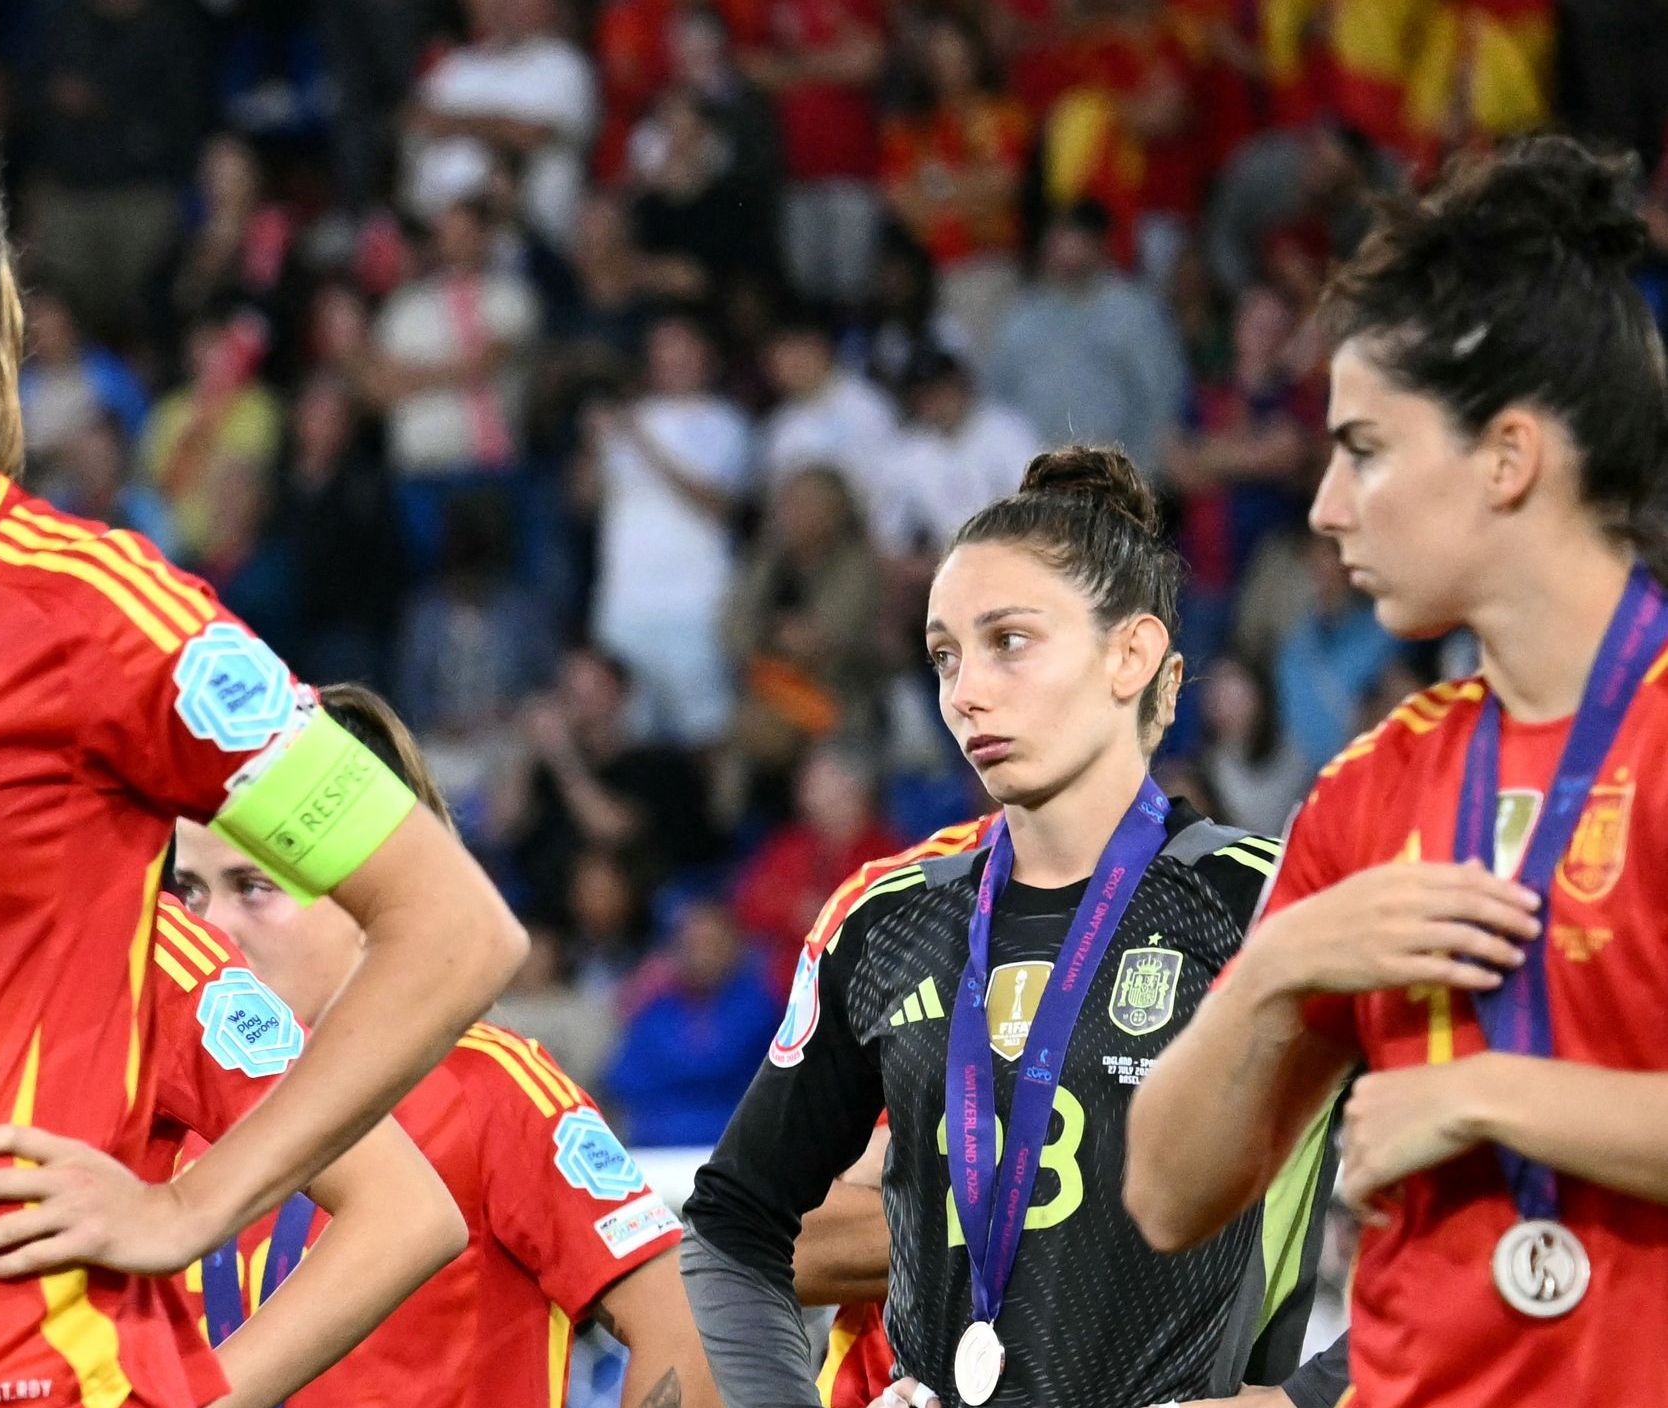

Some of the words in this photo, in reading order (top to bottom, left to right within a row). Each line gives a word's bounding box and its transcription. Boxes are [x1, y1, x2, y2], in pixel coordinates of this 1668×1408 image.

[1062, 903, 1110, 993] SWITZERLAND
[227, 1009, 246, 1023] We
[245, 1016, 280, 1044] Strong
[964, 1064, 979, 1165] SWITZERLAND
[937, 1085, 1085, 1248] 23
